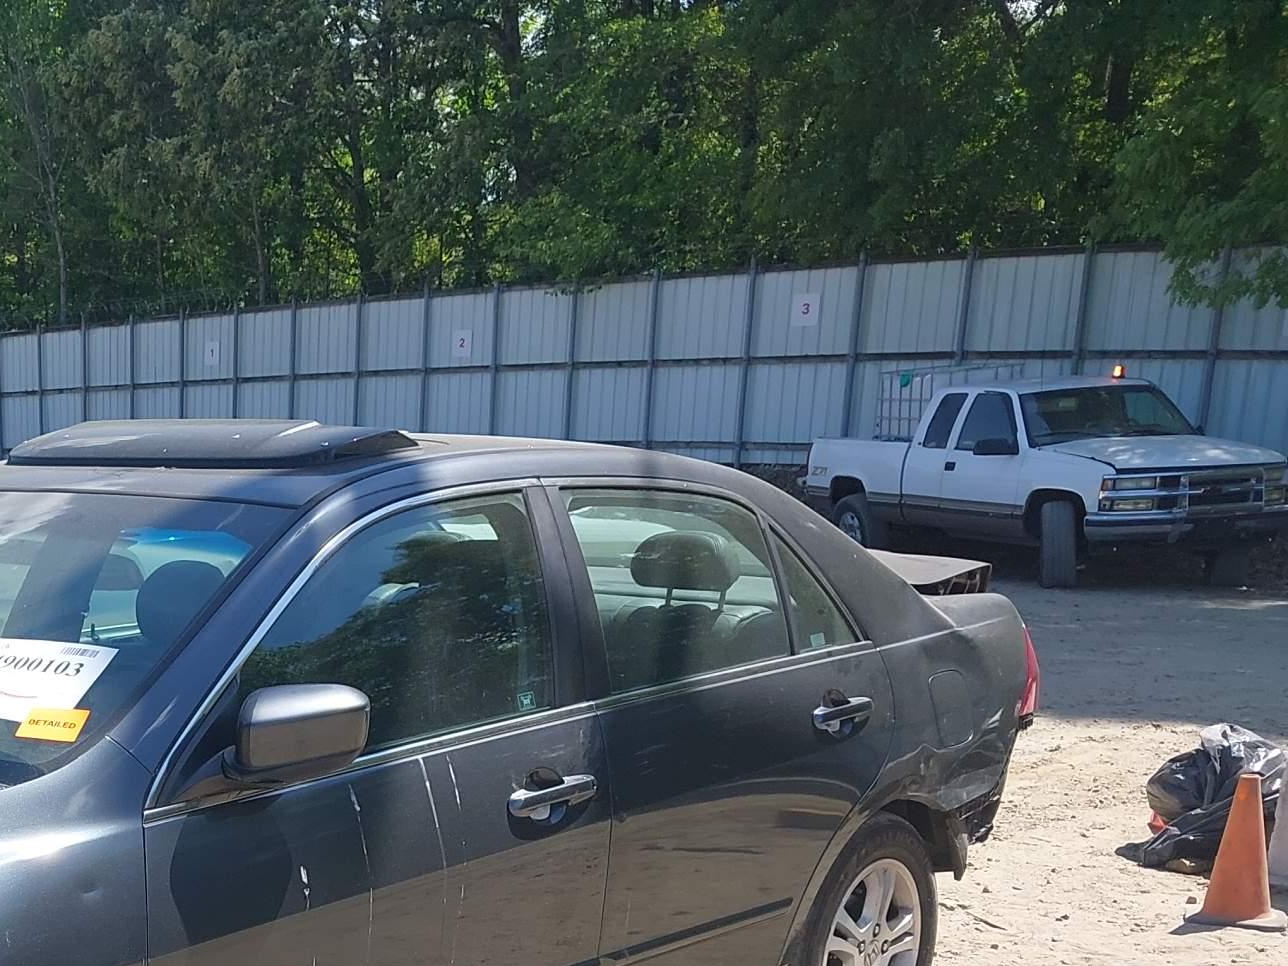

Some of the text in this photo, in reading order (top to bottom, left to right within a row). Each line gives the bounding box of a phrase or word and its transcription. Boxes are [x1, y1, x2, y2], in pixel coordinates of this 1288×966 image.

[802, 303, 810, 315] 3
[459, 337, 465, 348] 2
[28, 718, 77, 730] DETAILED
